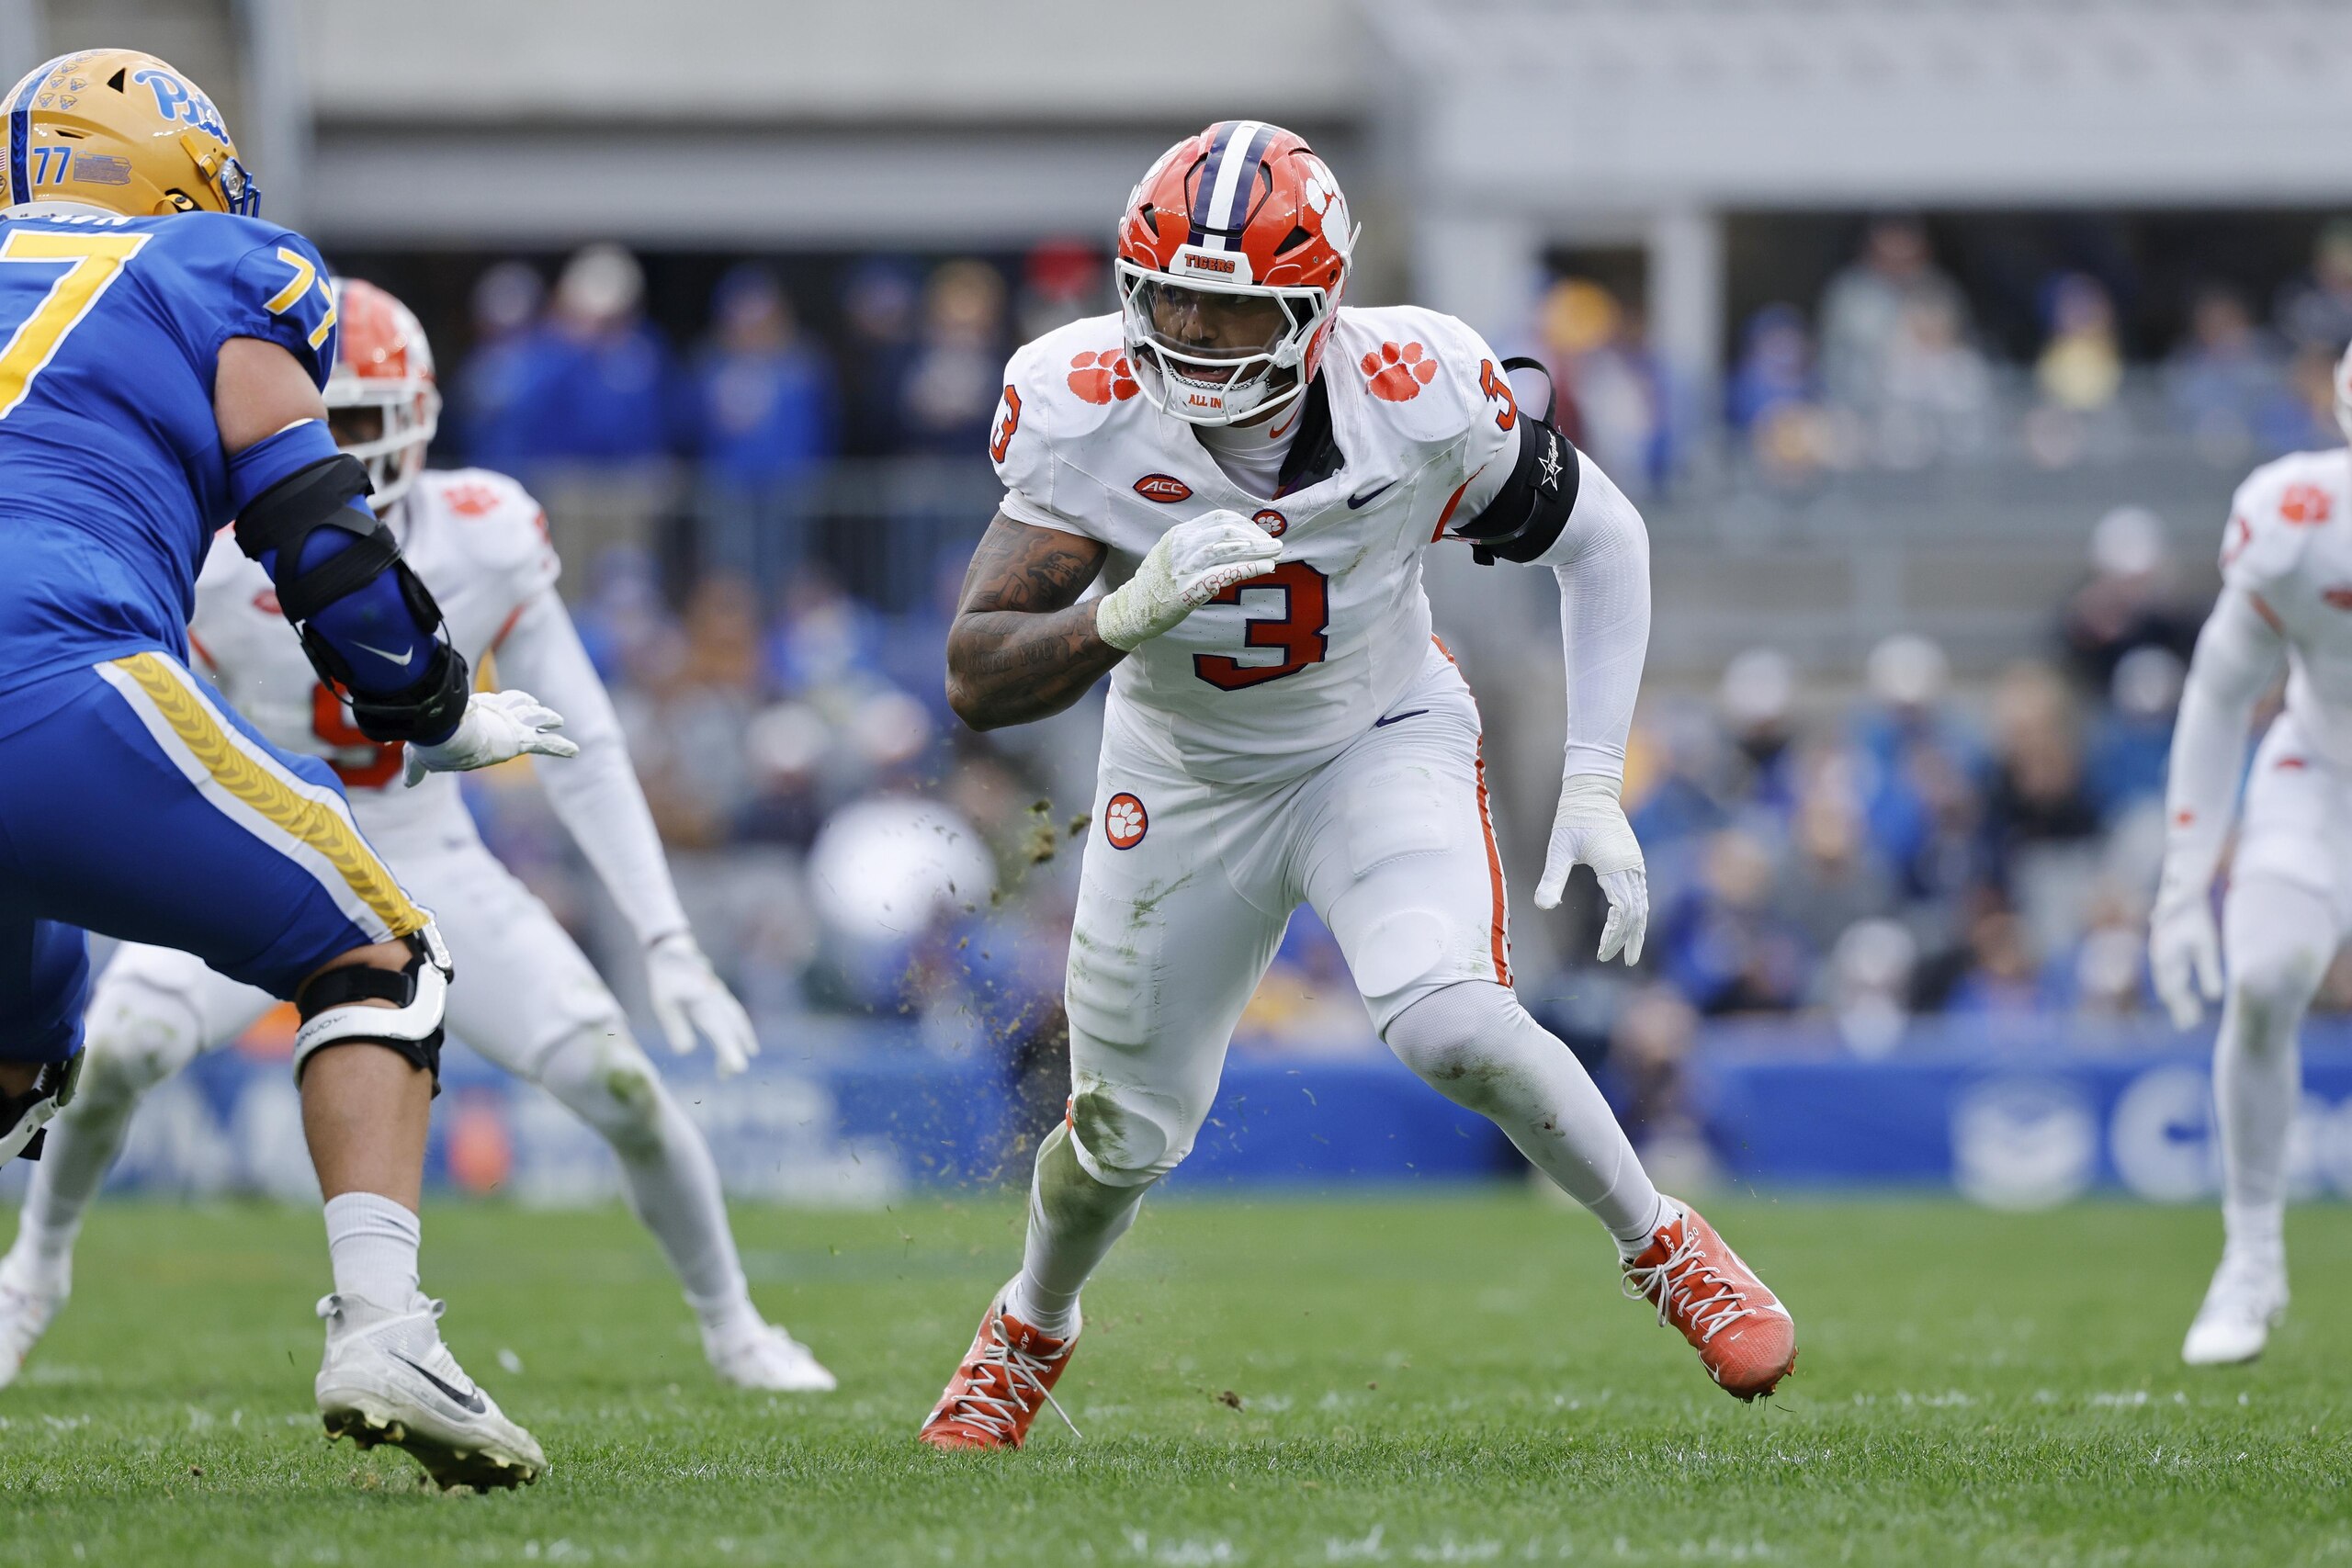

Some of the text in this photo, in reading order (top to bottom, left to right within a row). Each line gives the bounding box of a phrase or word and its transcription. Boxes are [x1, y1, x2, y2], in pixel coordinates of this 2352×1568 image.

[33, 146, 72, 186] 77
[1184, 253, 1235, 274] TIGERS
[1188, 393, 1222, 409] ALL IN
[1479, 358, 1518, 432] 3
[990, 384, 1022, 464] 3
[1141, 480, 1183, 495] ACC
[1193, 559, 1329, 692] 3
[1661, 1235, 1675, 1255] ALP
